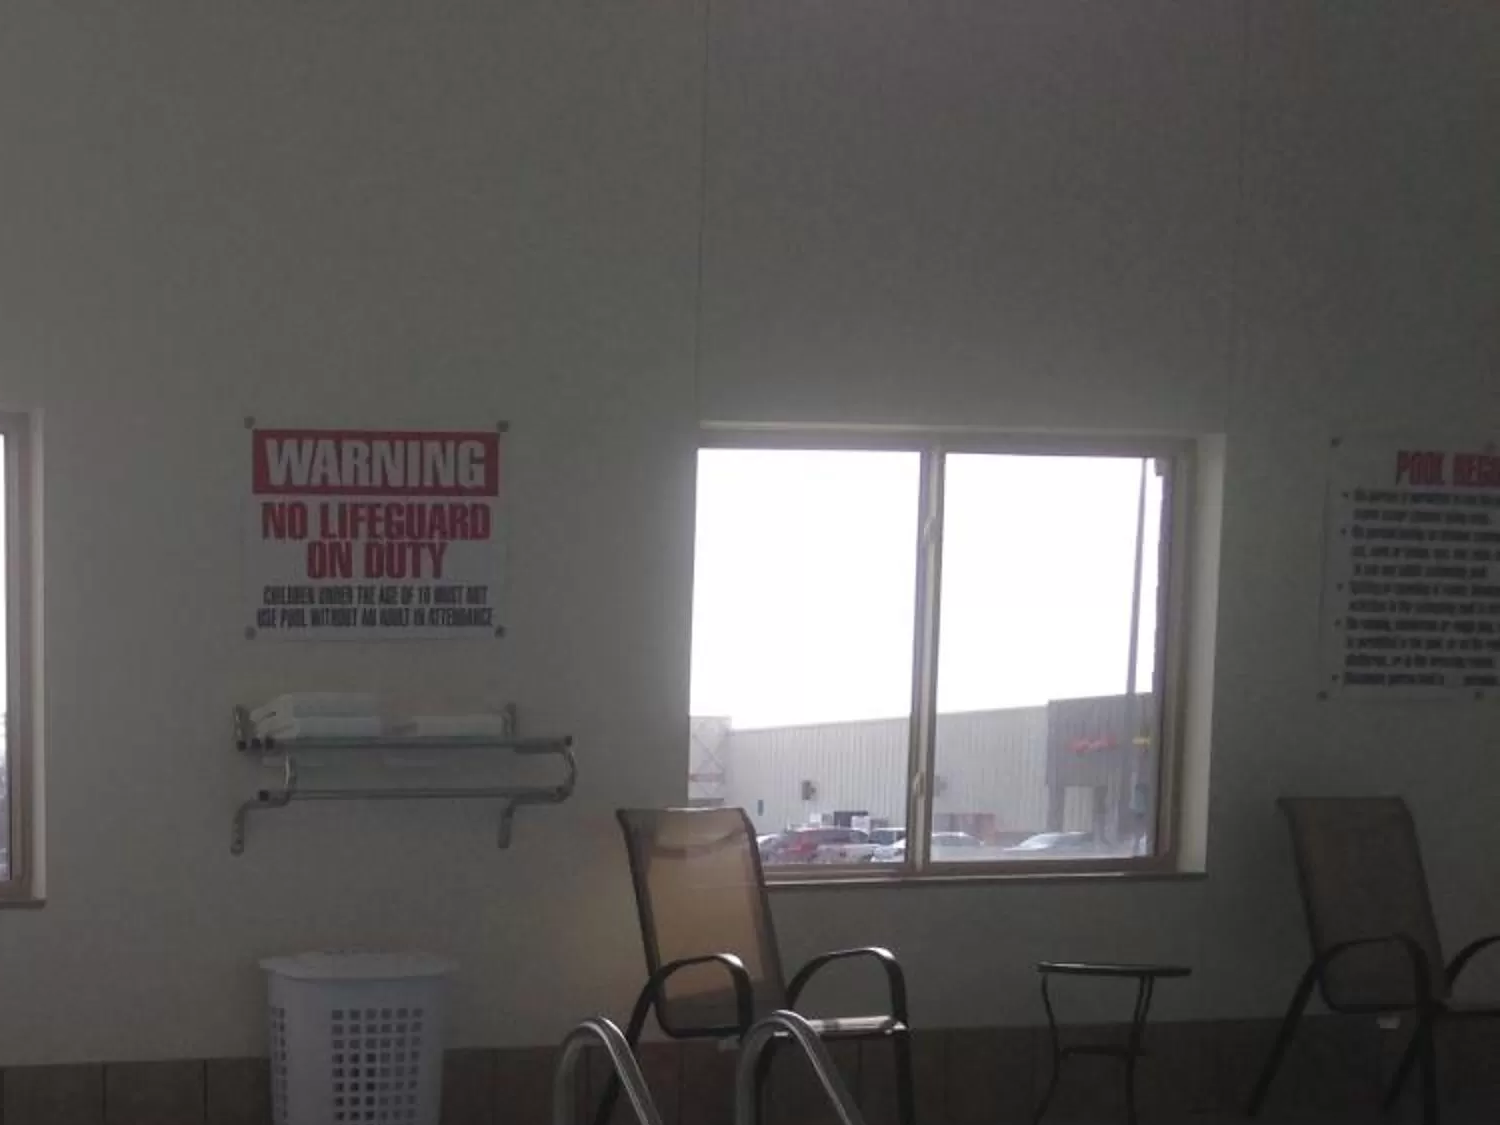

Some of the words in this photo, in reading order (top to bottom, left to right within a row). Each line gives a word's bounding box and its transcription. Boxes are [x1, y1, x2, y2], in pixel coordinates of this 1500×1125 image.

[265, 438, 486, 489] WARNING
[261, 502, 308, 540] NO
[320, 502, 491, 541] LIFEGUARD
[307, 541, 353, 580] ON
[364, 541, 449, 580] DUTY
